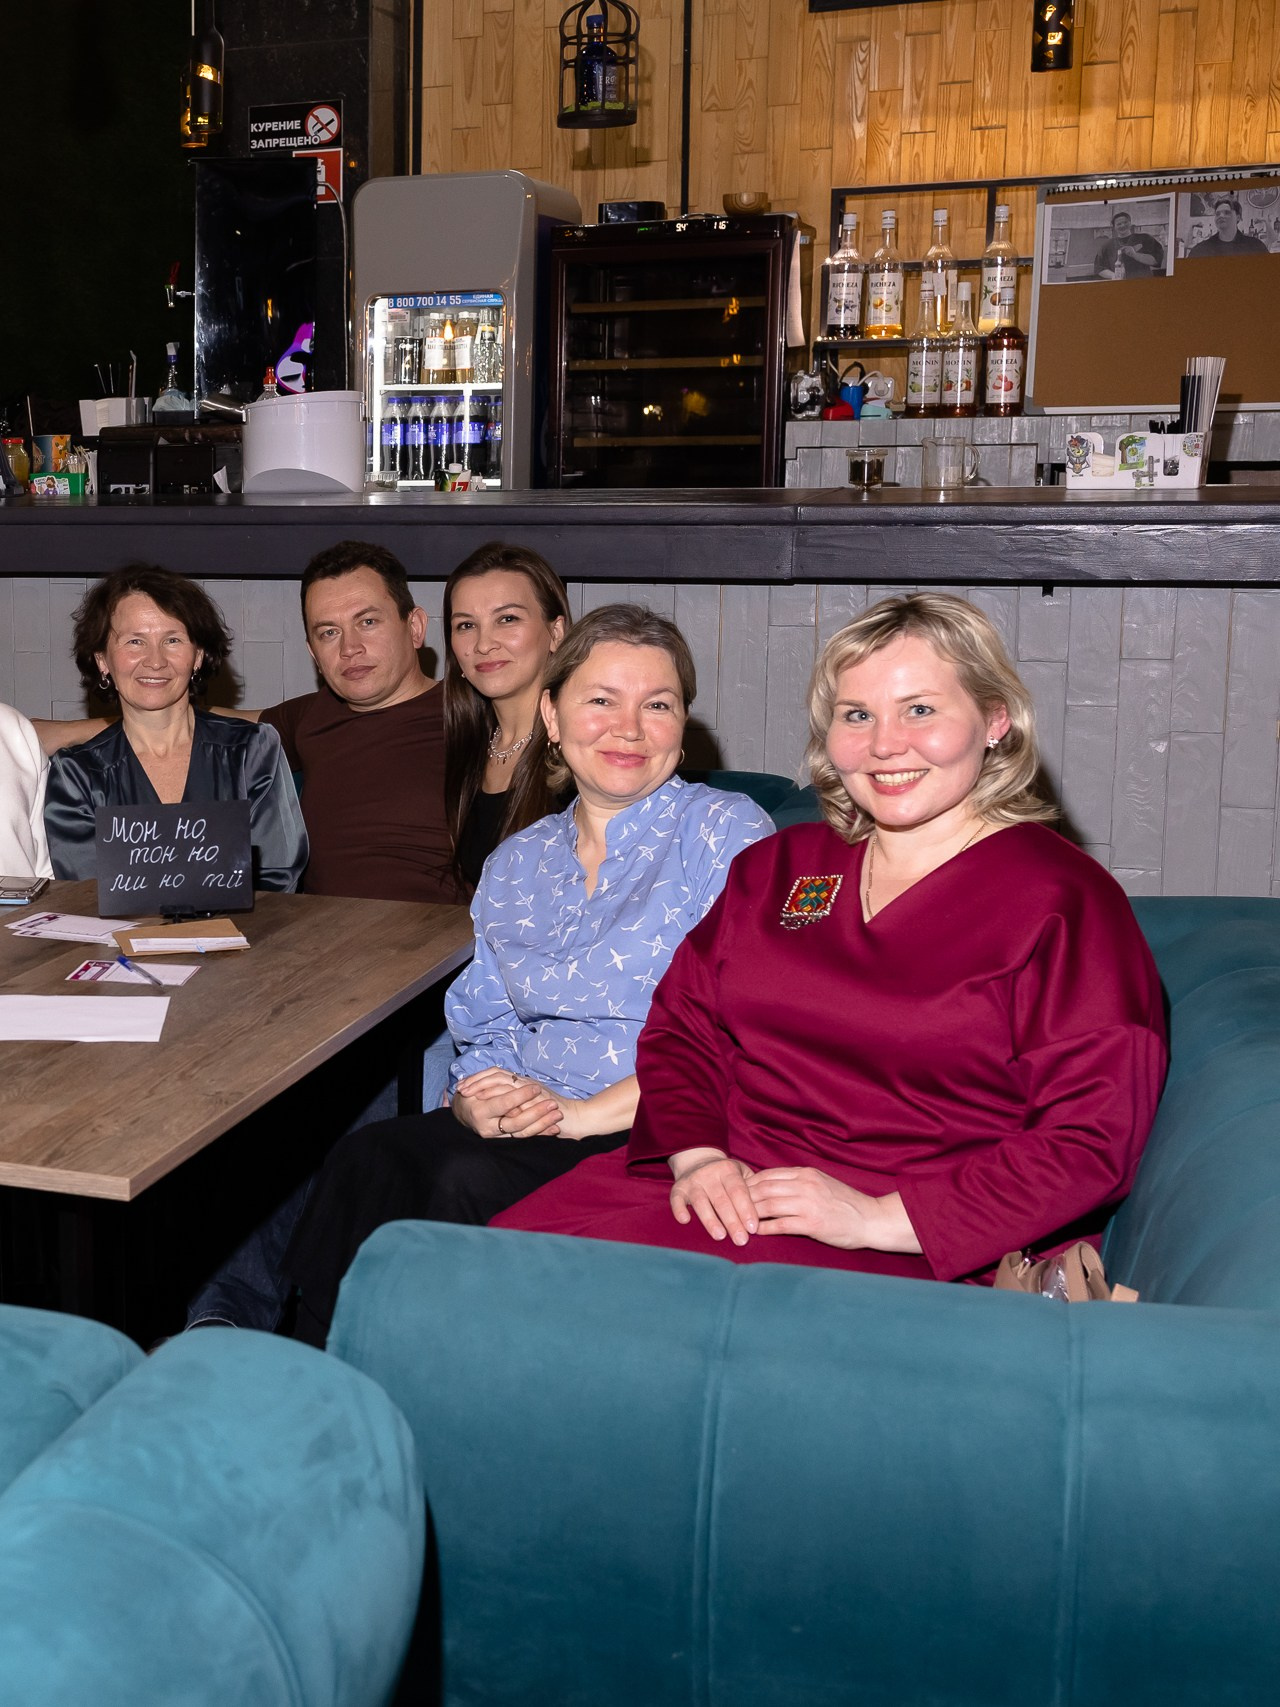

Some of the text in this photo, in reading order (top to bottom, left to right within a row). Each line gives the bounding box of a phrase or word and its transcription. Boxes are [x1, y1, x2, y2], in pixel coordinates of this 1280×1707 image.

[250, 120, 301, 133] КУРЕНИЕ
[250, 135, 321, 149] ЗАПРЕЩЕНО
[388, 295, 461, 308] 8 800 700 14 55
[103, 816, 162, 844] Мон
[129, 845, 179, 865] тон
[110, 873, 149, 892] ми
[158, 873, 185, 889] но
